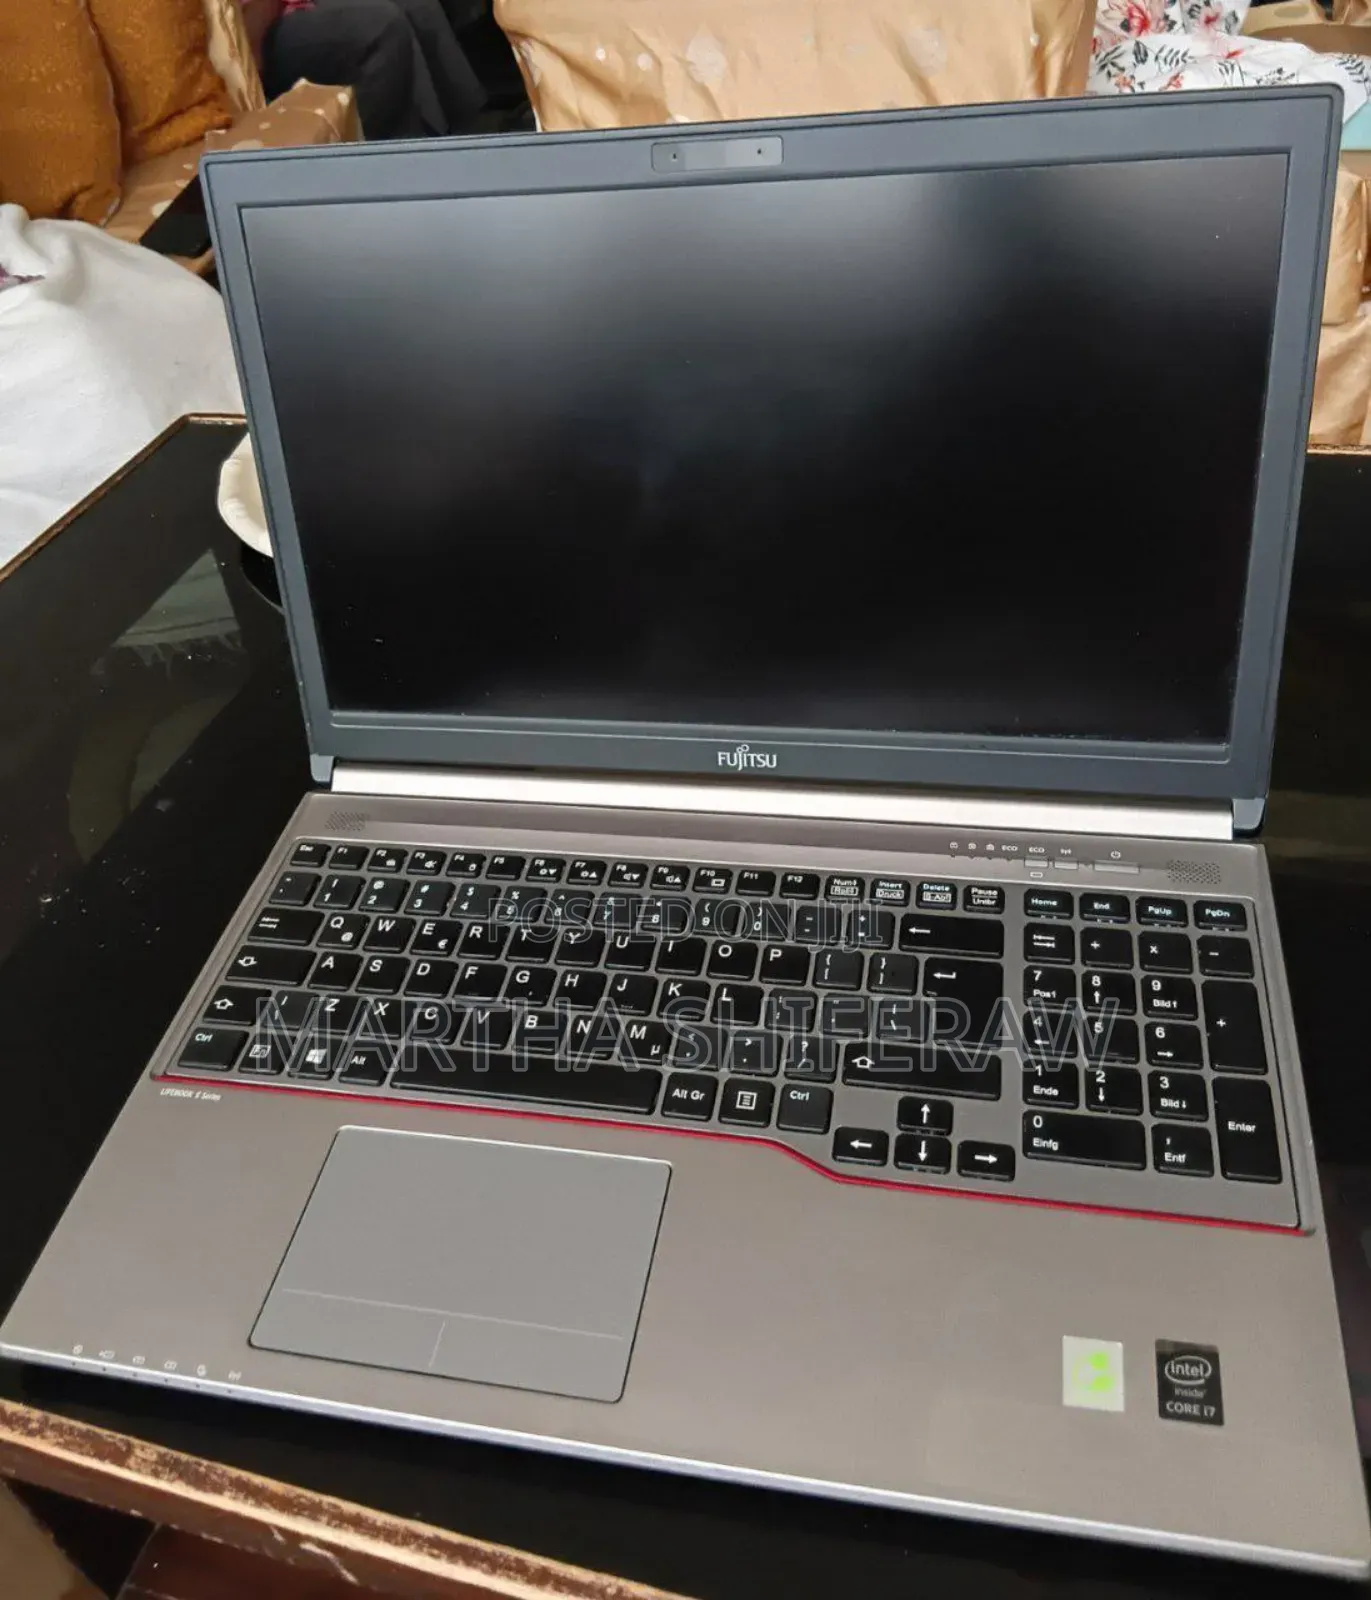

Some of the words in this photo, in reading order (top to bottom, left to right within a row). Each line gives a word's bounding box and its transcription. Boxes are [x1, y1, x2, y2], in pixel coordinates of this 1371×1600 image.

[717, 744, 777, 771] FUJITSU
[376, 849, 387, 857] F2
[1001, 845, 1018, 853] ECO
[1028, 846, 1045, 854] ECO
[414, 851, 426, 860] F3
[454, 854, 466, 862] F4
[494, 856, 505, 865] F5
[575, 861, 586, 869] F7
[615, 864, 627, 872] F8
[658, 866, 669, 874] F9
[700, 870, 715, 878] F10
[743, 872, 759, 880] F11
[787, 875, 803, 883] F12
[879, 881, 902, 889] Insert
[923, 883, 950, 892] Delete
[323, 892, 331, 902] 1
[971, 887, 998, 896] Pause
[367, 895, 377, 905] 2
[413, 898, 423, 909] 3
[460, 901, 469, 911] 4
[1031, 898, 1058, 907] Home
[1093, 902, 1110, 911] End
[1148, 905, 1173, 917] PgUp
[651, 914, 660, 924] 8
[1205, 908, 1230, 919] PgDn
[330, 916, 345, 929] Q
[378, 919, 396, 932] W
[702, 917, 711, 927] 9
[421, 922, 437, 936] E
[469, 925, 483, 939] R
[521, 928, 532, 941] T
[569, 932, 581, 945] Y
[616, 936, 629, 949] U
[718, 944, 732, 958] O
[769, 948, 782, 961] P
[321, 955, 335, 969] A
[369, 959, 383, 972] S
[416, 962, 431, 976] D
[464, 966, 479, 980] F
[515, 970, 531, 984] G
[564, 973, 580, 987] H
[1033, 970, 1042, 981] 7
[1092, 975, 1101, 987] 8
[616, 978, 628, 992] J
[668, 982, 683, 997] K
[1151, 979, 1161, 992] 9
[721, 988, 732, 1001] L
[1033, 988, 1057, 999] Pos1
[324, 998, 341, 1012] Z
[373, 1001, 390, 1016] X
[1153, 998, 1171, 1009] Bild
[424, 1006, 439, 1020] C
[476, 1010, 491, 1025] V
[524, 1014, 539, 1029] B
[576, 1019, 592, 1035] N
[1033, 1016, 1043, 1028] 4
[1094, 1021, 1104, 1034] 5
[195, 1033, 213, 1042] Ctrl
[630, 1024, 647, 1040] M
[1155, 1027, 1166, 1039] 6
[350, 1055, 367, 1065] Alt
[1035, 1065, 1043, 1077] 1
[1095, 1070, 1106, 1084] 2
[1160, 1076, 1170, 1089] 3
[672, 1088, 688, 1099] Alt
[690, 1090, 706, 1102] Gr
[789, 1090, 810, 1101] Ctrl
[1033, 1085, 1059, 1097] Ende
[1160, 1098, 1180, 1109] Bild
[1033, 1115, 1043, 1128] 0
[1228, 1121, 1256, 1133] Enter
[1033, 1137, 1059, 1152] Einfg
[1164, 1152, 1187, 1164] Entf
[1166, 1400, 1200, 1416] CORE
